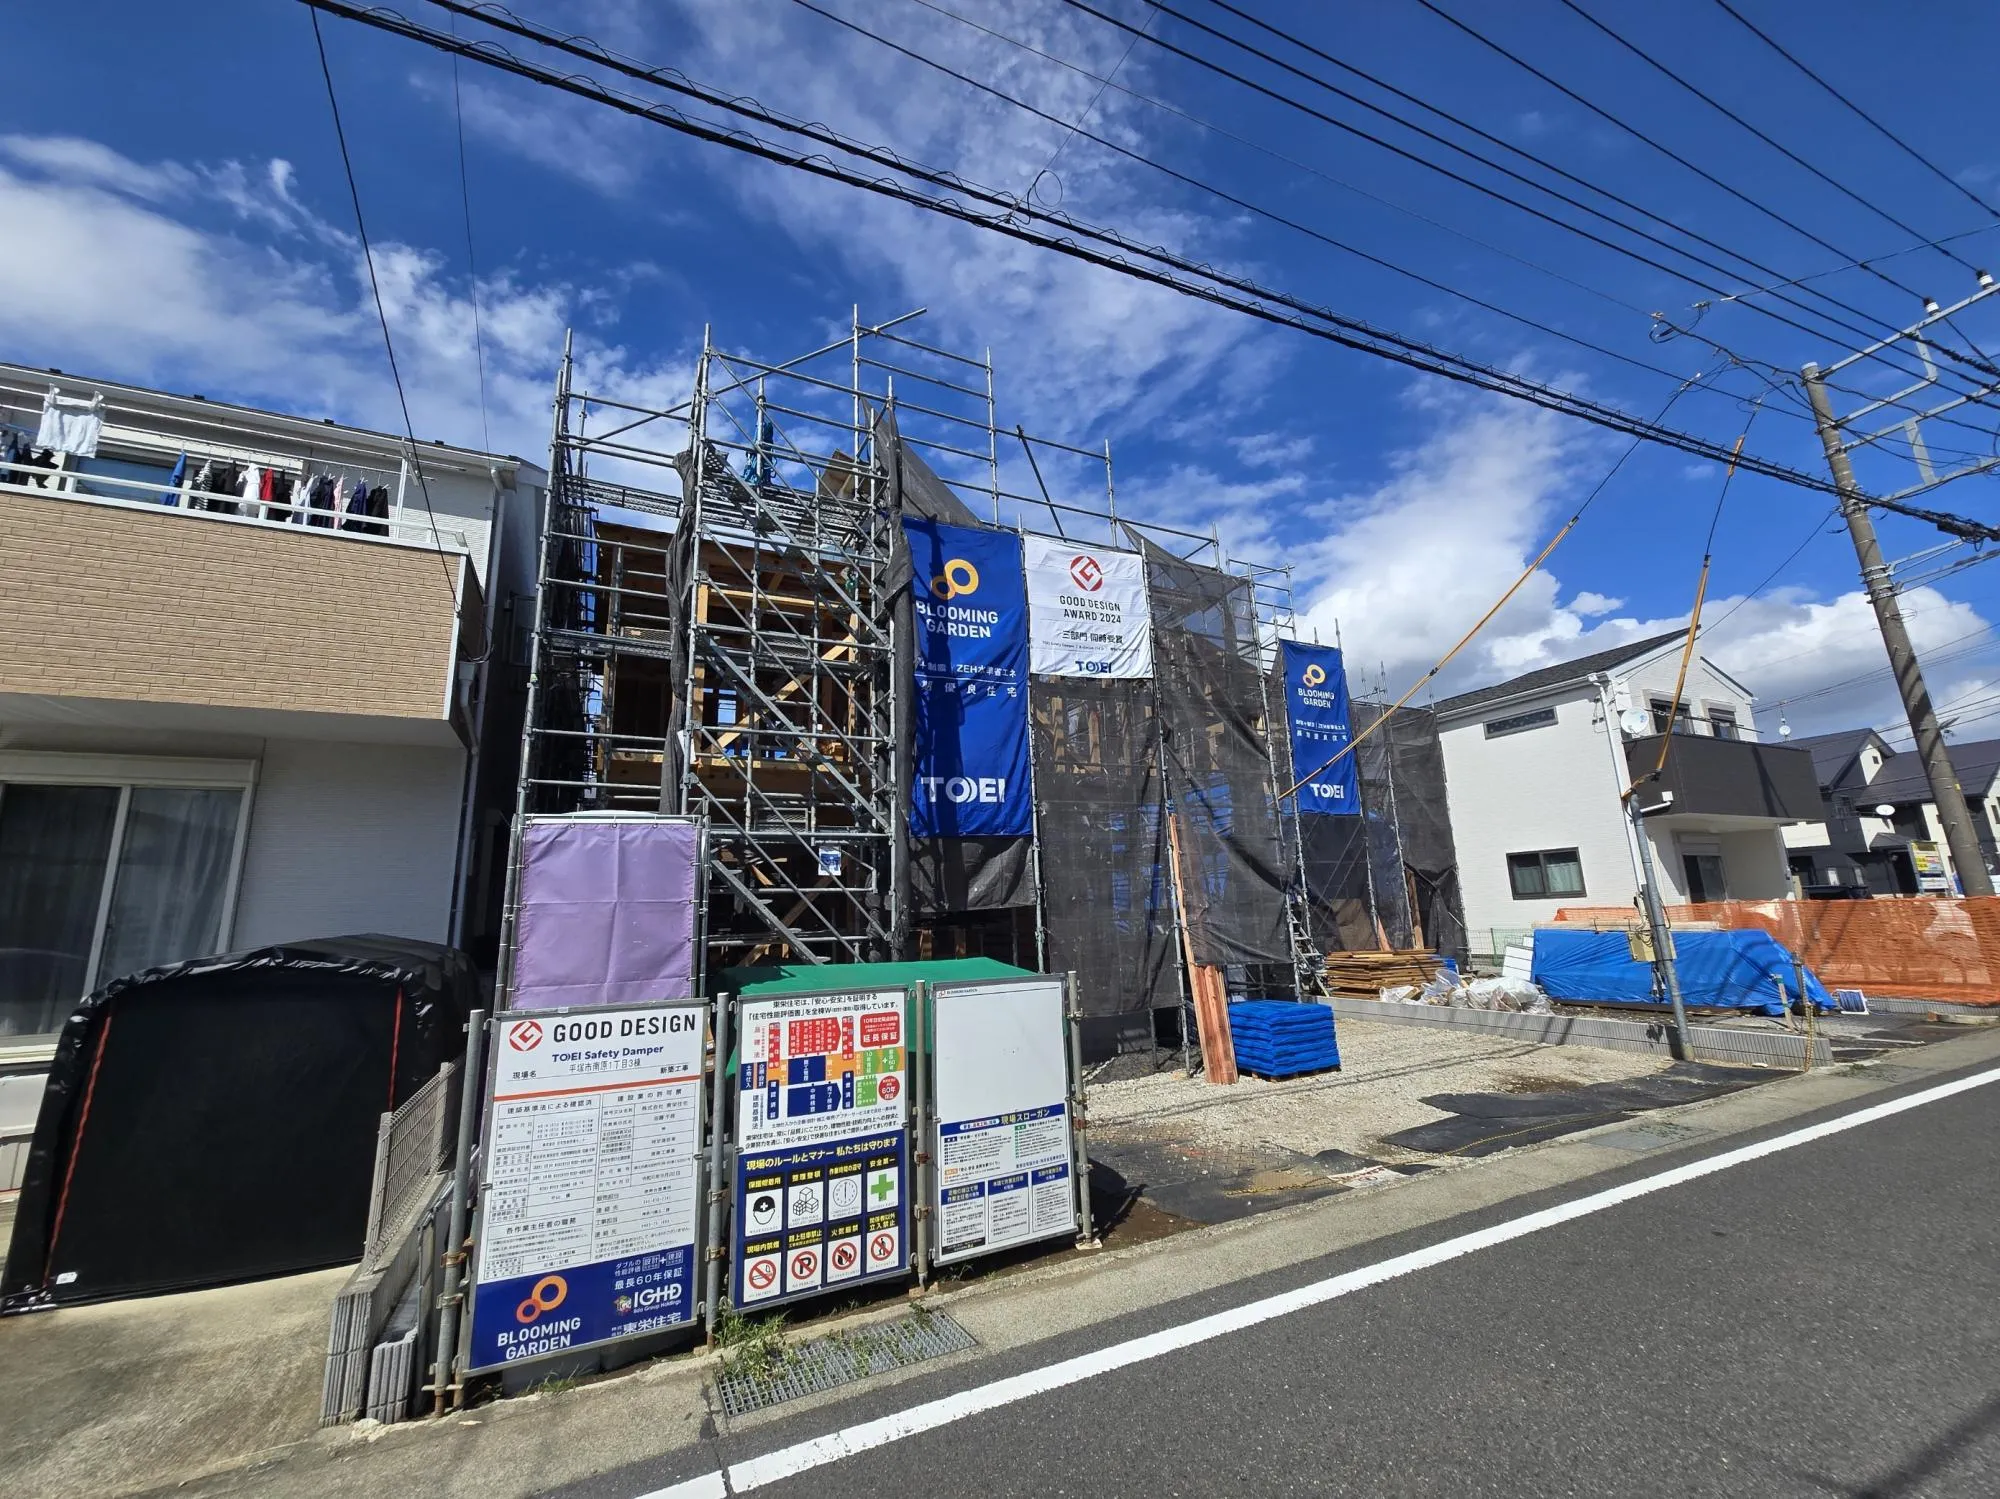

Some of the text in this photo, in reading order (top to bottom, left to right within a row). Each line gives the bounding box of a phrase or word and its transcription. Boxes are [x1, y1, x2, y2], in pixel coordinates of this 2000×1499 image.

[1060, 596, 1120, 612] GOOD DESIGN
[916, 600, 998, 624] BLOOMING
[1064, 609, 1121, 624] AWARD 2024
[926, 619, 991, 638] GARDEN
[1062, 630, 1123, 644] 三部門 同時受賞
[956, 664, 1016, 678] ZEH水準省エネ
[1075, 660, 1112, 674] TOEI
[1298, 688, 1334, 700] BLOOMING
[1304, 697, 1331, 708] GARDEN
[920, 776, 1006, 803] TOEI
[1310, 783, 1344, 798] TOEI
[553, 1014, 696, 1043] GOOD DESIGN
[863, 1032, 897, 1042] 延長保証
[584, 1048, 620, 1060] Safety
[622, 1046, 664, 1058] Damper
[512, 1070, 537, 1080] 現場名
[660, 1064, 689, 1074] 新築工事
[1001, 1109, 1050, 1124] 現場スローガン
[746, 1137, 898, 1171] 現場のルールとマナー 私たちは守ります
[870, 1158, 896, 1168] 安全第一
[792, 1171, 820, 1182] 整理整頓
[831, 1225, 858, 1237] 火気厳禁
[869, 1220, 896, 1230] 立入禁止
[789, 1230, 822, 1243] 路上駐車禁止
[746, 1241, 780, 1254] 現場内禁煙
[643, 1256, 659, 1265] 設計
[667, 1252, 683, 1260] 建設
[615, 1266, 641, 1276] 性能評価
[616, 1259, 641, 1270] ダブルの
[614, 1267, 683, 1290] 最長60年保証
[634, 1283, 682, 1308] IGHD
[624, 1312, 681, 1336] 東栄住宅
[497, 1317, 581, 1346] BLOOMING
[506, 1334, 571, 1360] GARDEN
